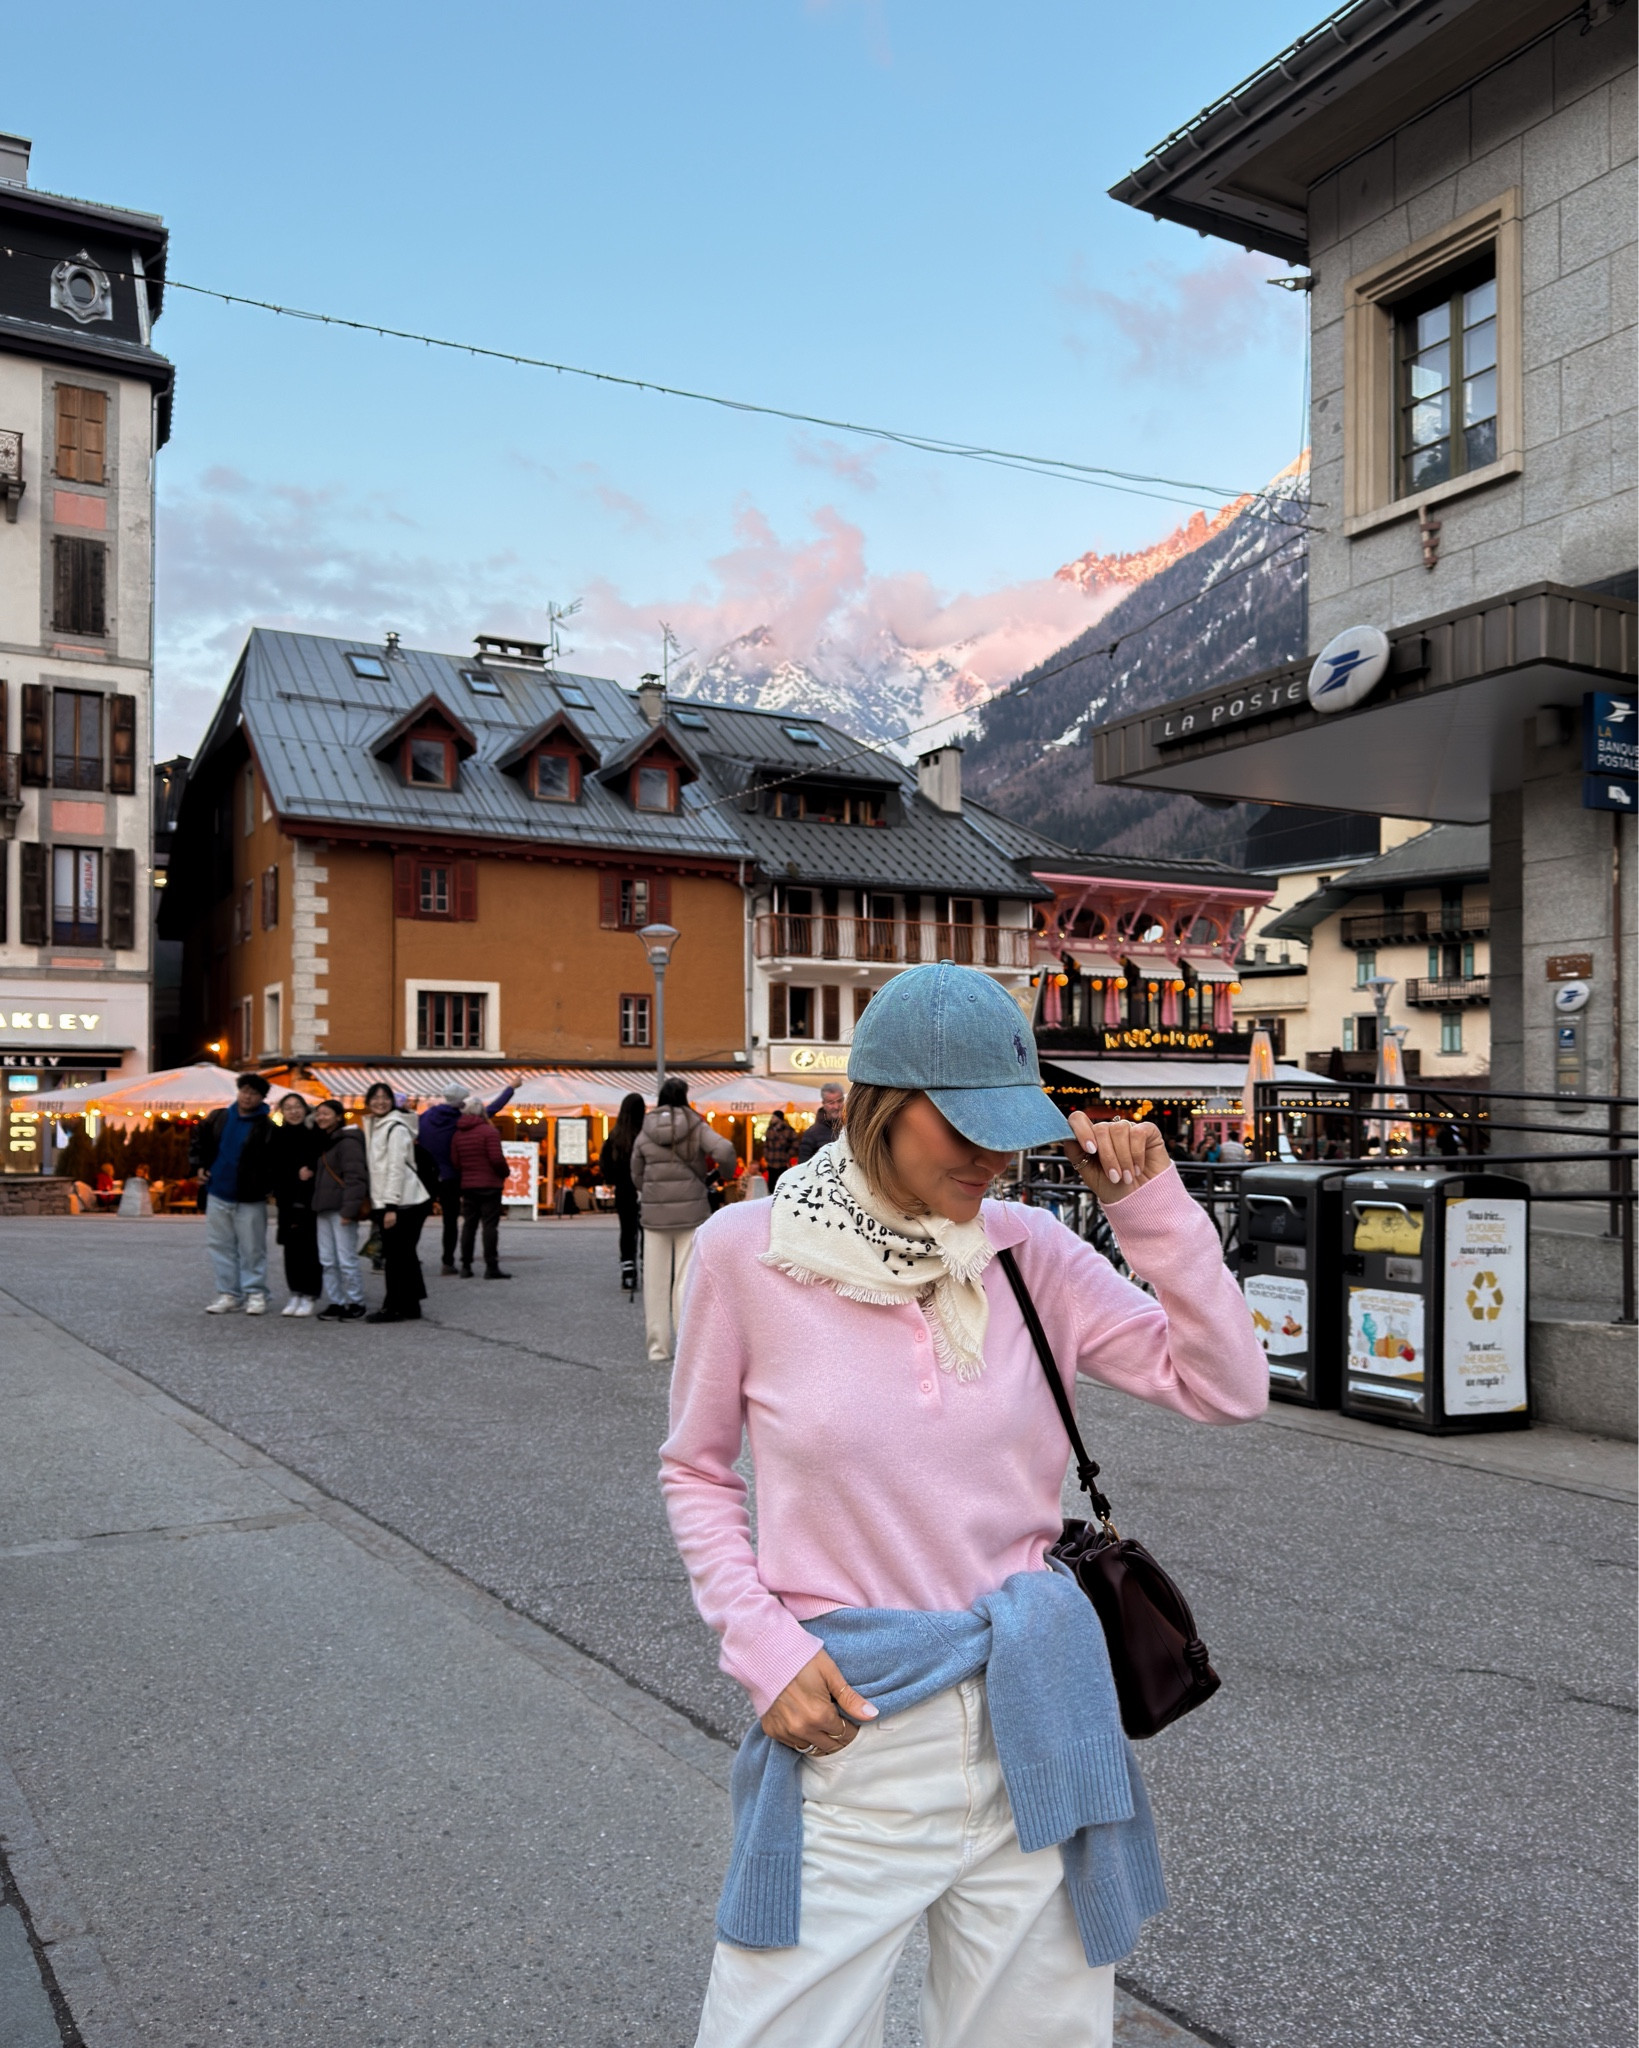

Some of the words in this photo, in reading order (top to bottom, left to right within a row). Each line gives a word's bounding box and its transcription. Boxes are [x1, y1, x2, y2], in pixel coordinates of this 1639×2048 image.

[1164, 714, 1195, 736] LA
[1211, 680, 1303, 722] POSTE
[1597, 725, 1612, 738] LA
[1598, 739, 1638, 758] BANQUE
[1597, 753, 1638, 772] POSTALE
